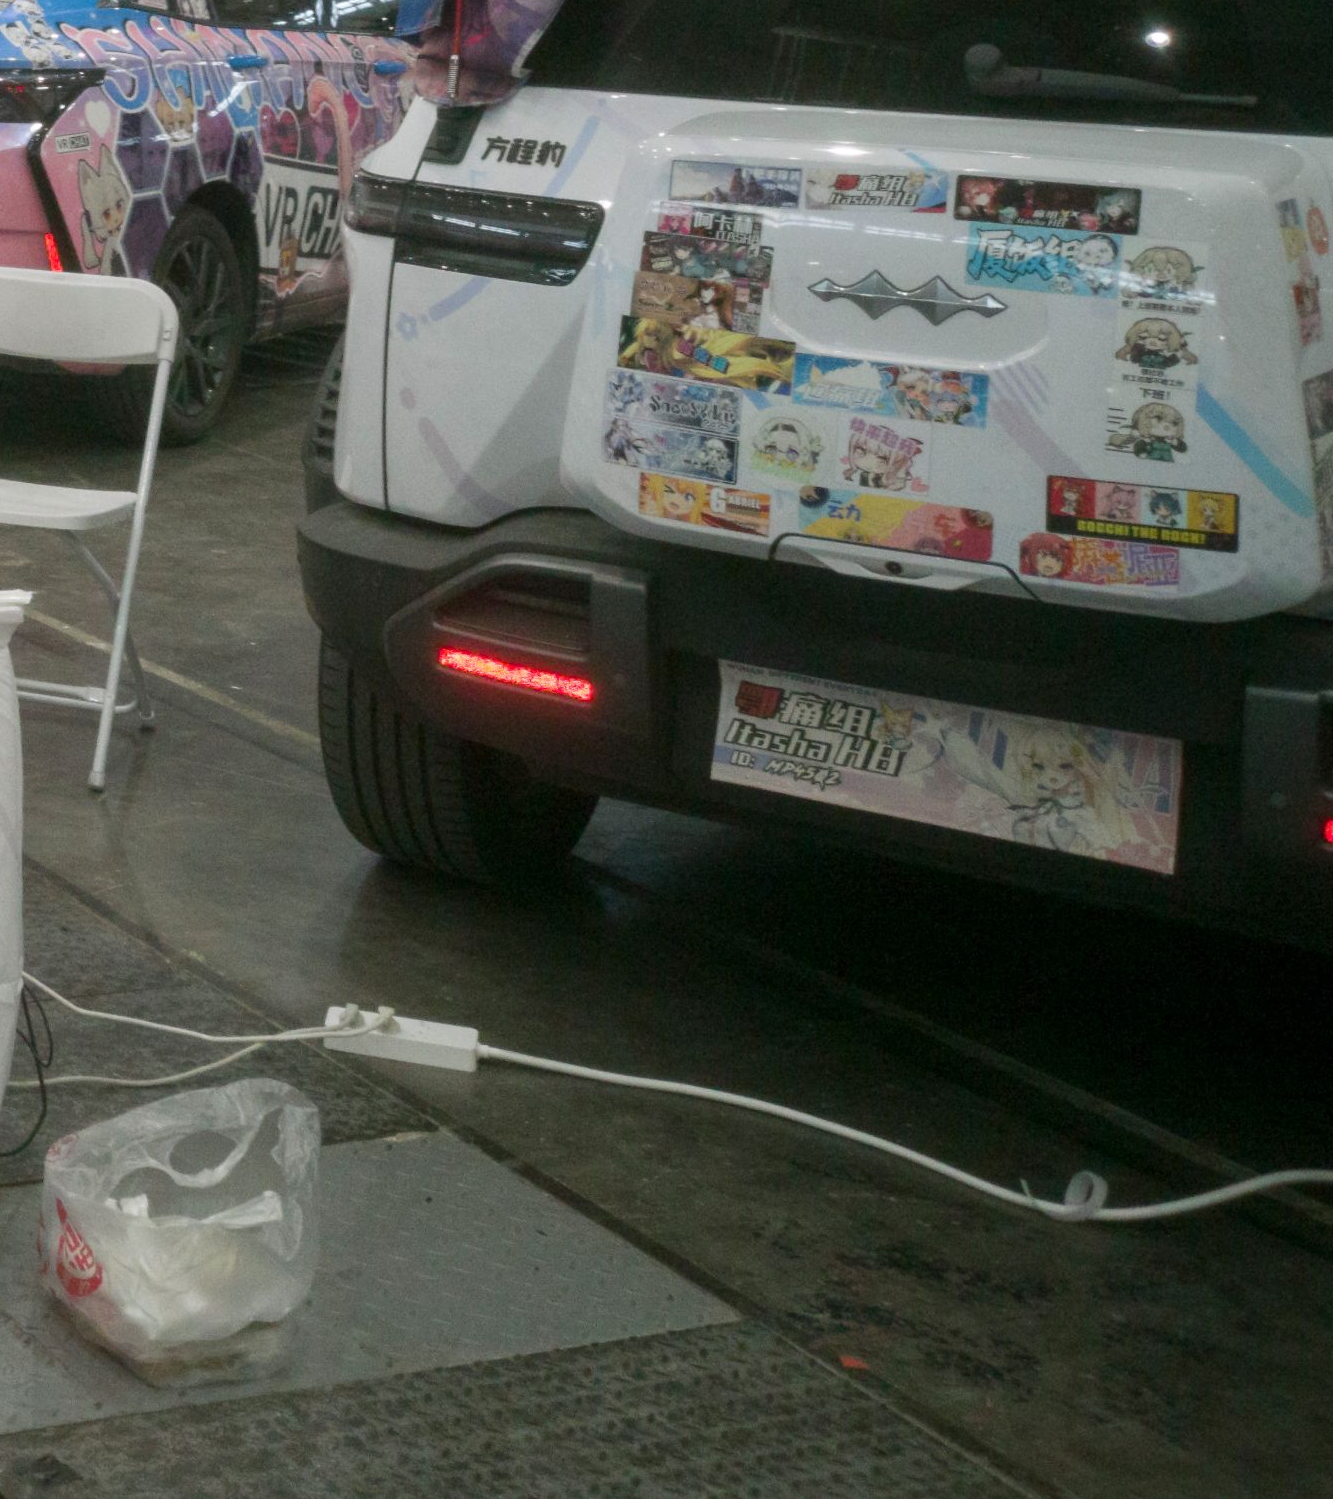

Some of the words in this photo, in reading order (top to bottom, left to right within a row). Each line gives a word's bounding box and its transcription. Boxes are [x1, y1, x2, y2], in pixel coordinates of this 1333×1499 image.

[481, 135, 566, 168] 方程豹
[301, 190, 342, 255] CH
[725, 718, 831, 762] Itasha
[732, 750, 755, 768] ID:
